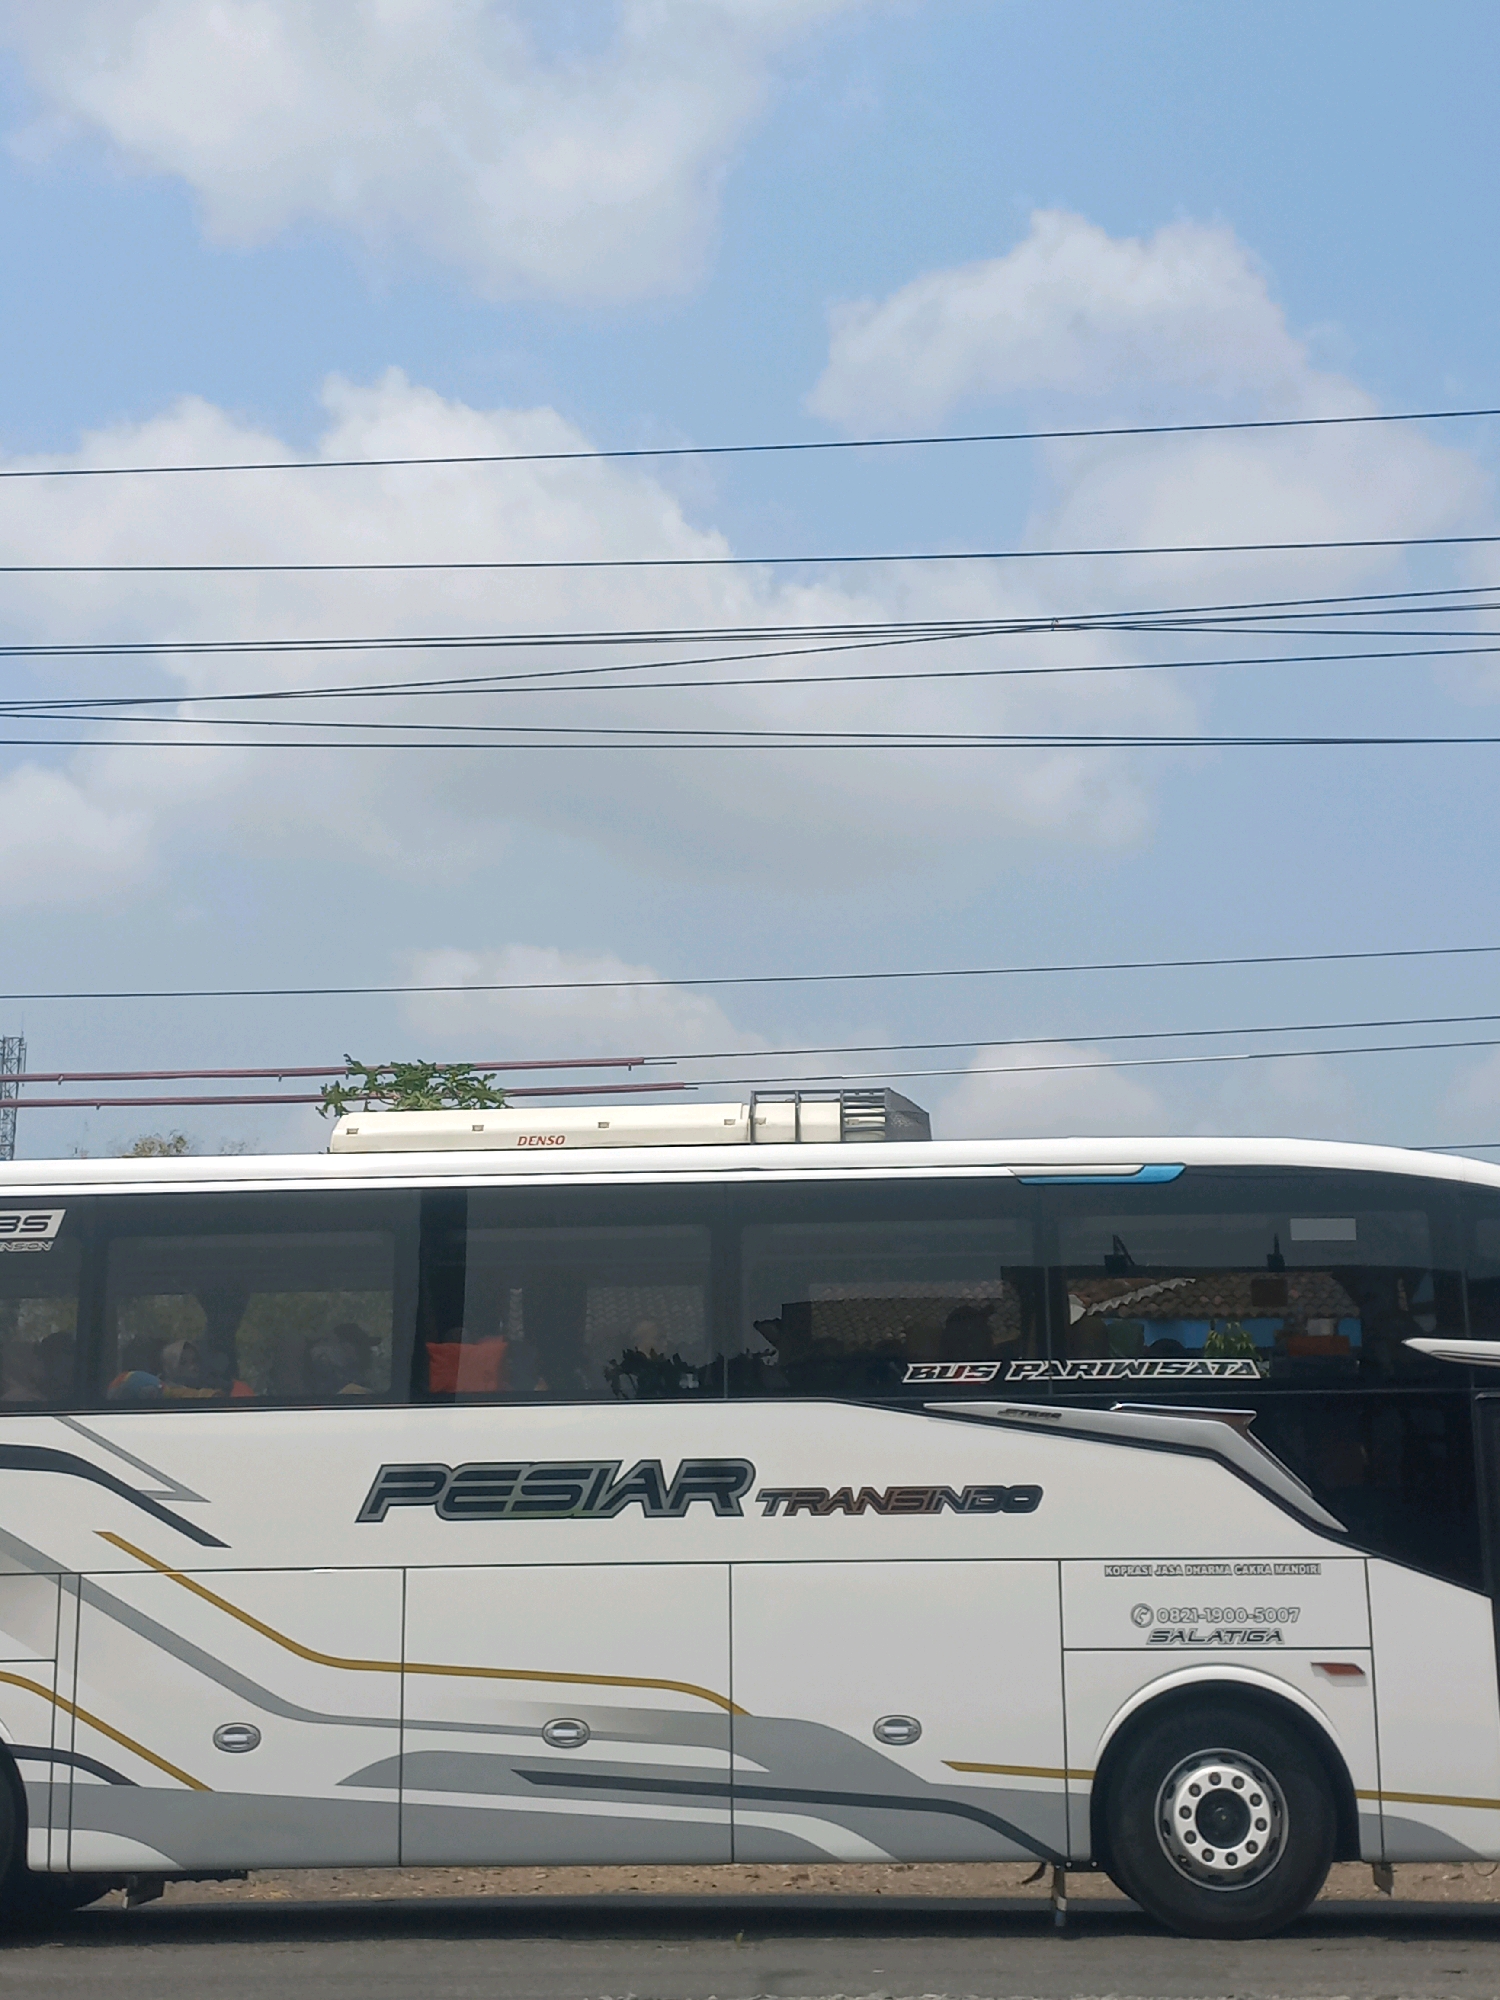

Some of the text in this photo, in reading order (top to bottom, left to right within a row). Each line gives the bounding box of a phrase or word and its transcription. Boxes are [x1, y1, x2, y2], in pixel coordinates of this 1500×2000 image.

[517, 1135, 566, 1146] DENSO
[903, 1358, 1262, 1383] BUS PARIWISATA
[355, 1458, 1043, 1523] PESIAR TRANSINDO
[1105, 1563, 1321, 1577] KOPRASI JASA DHARMA CAKRA MANDIRI
[1157, 1607, 1300, 1623] 0821-1900-5007
[1146, 1628, 1285, 1645] SALATIGA
